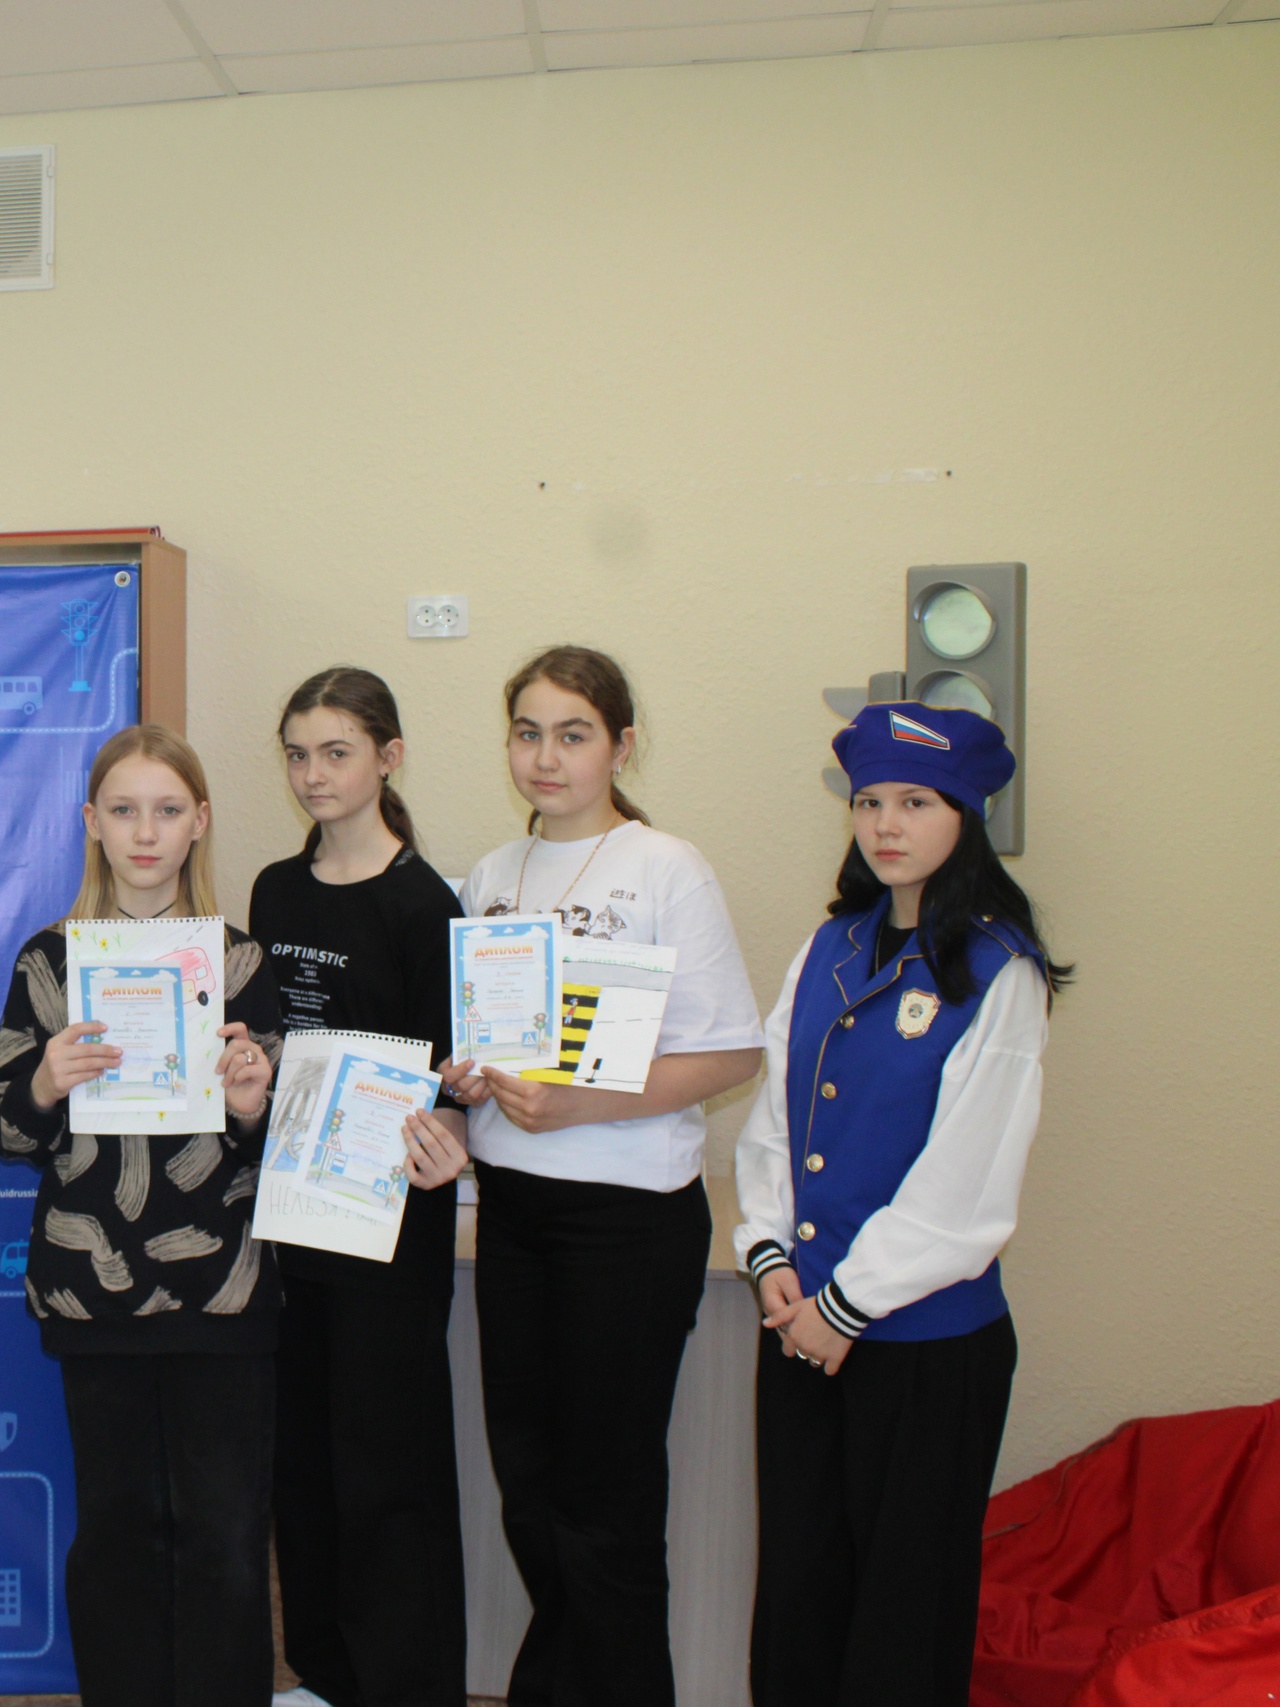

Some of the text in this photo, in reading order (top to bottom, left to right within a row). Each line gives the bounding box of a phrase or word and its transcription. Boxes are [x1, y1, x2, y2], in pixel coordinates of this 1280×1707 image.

[271, 943, 348, 968] OPTIMSTIC
[475, 945, 533, 957] ДИПЛОМ
[102, 987, 162, 997] ДИПЛОМ
[354, 1081, 414, 1105] ДИПЛОМ
